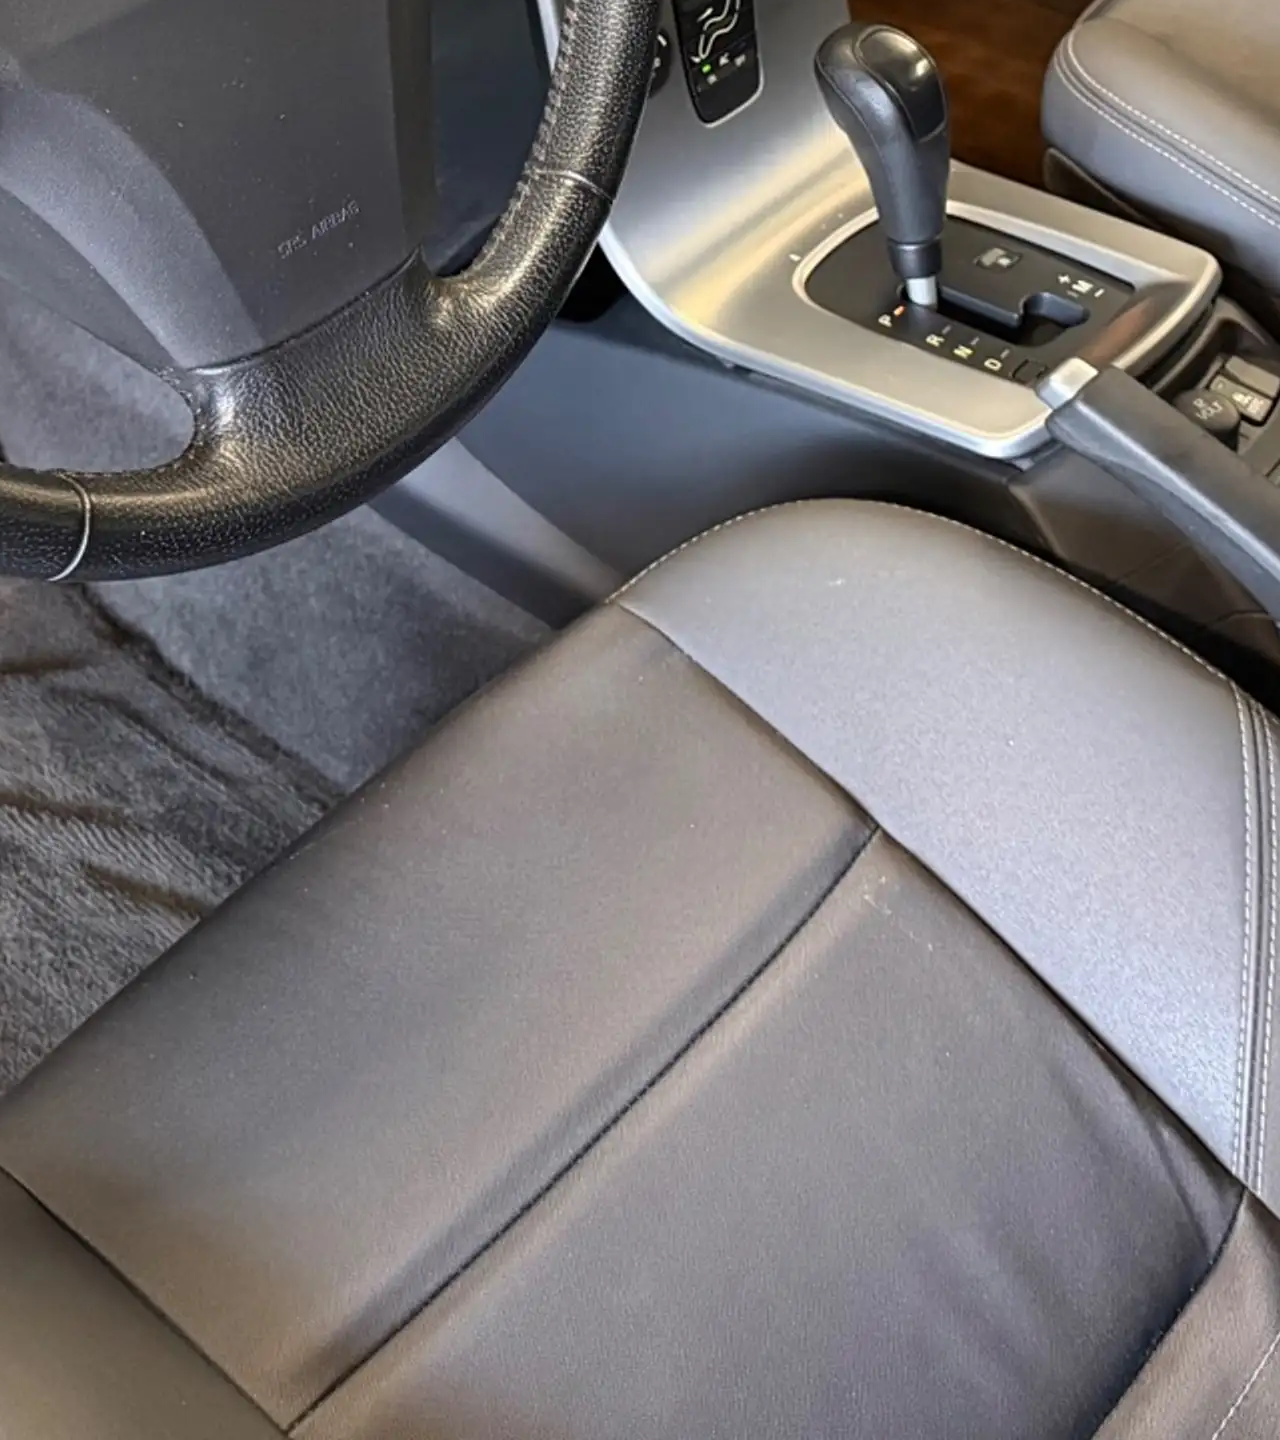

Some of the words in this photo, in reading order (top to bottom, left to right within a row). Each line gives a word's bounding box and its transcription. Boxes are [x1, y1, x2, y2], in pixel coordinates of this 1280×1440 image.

[877, 313, 893, 328] P
[925, 333, 946, 348] R
[952, 344, 974, 360] N
[983, 357, 1003, 372] D
